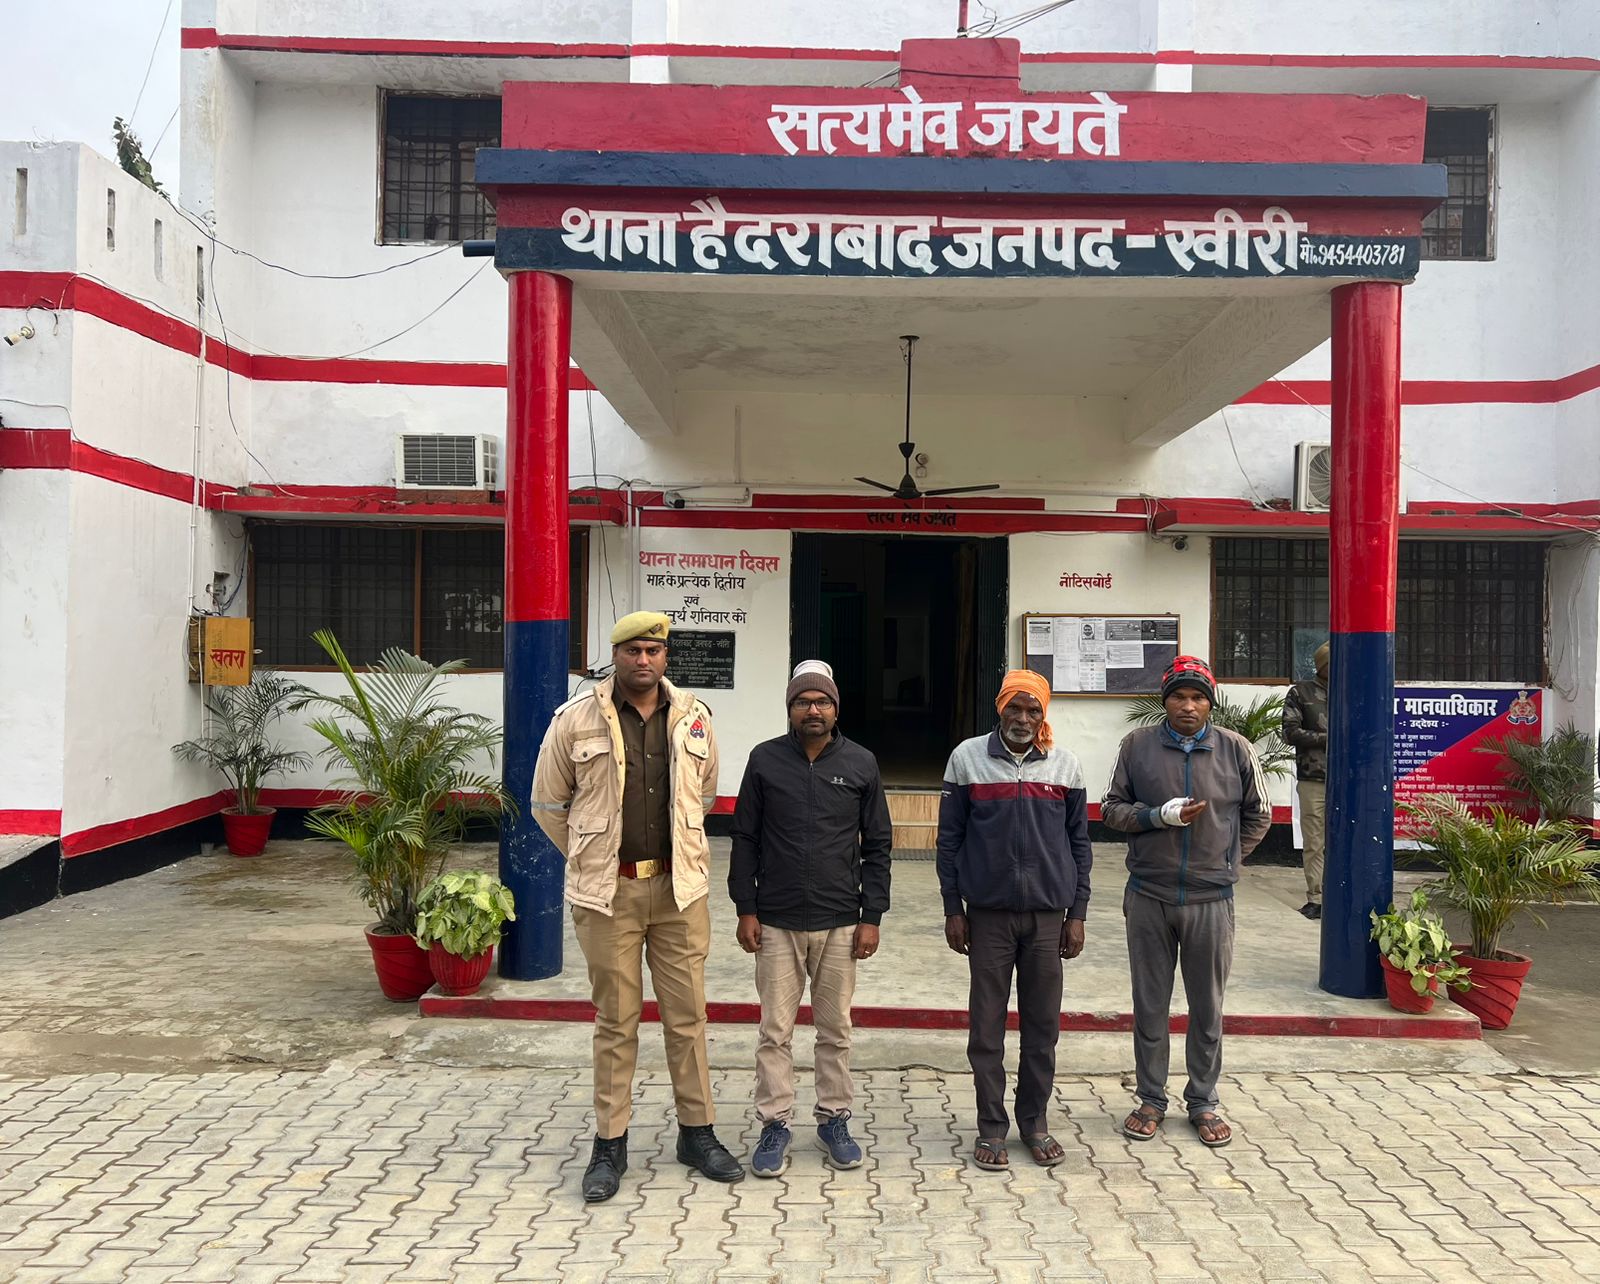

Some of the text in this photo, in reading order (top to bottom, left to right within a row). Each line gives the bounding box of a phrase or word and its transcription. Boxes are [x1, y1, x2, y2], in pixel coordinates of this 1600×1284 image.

[967, 92, 1128, 156] जयते
[560, 207, 681, 267] थाना
[682, 196, 939, 274] हैदराबाद
[941, 217, 1126, 271] जनपद
[1164, 206, 1308, 275] खीरी
[639, 549, 780, 574] थाना समाधान दिवस
[646, 574, 666, 590] माह
[713, 571, 746, 591] द्वितीय
[658, 607, 747, 625] तुर्थ शनिवार को
[210, 649, 246, 670] खतरा
[1403, 693, 1498, 716] मानवाधिकार
